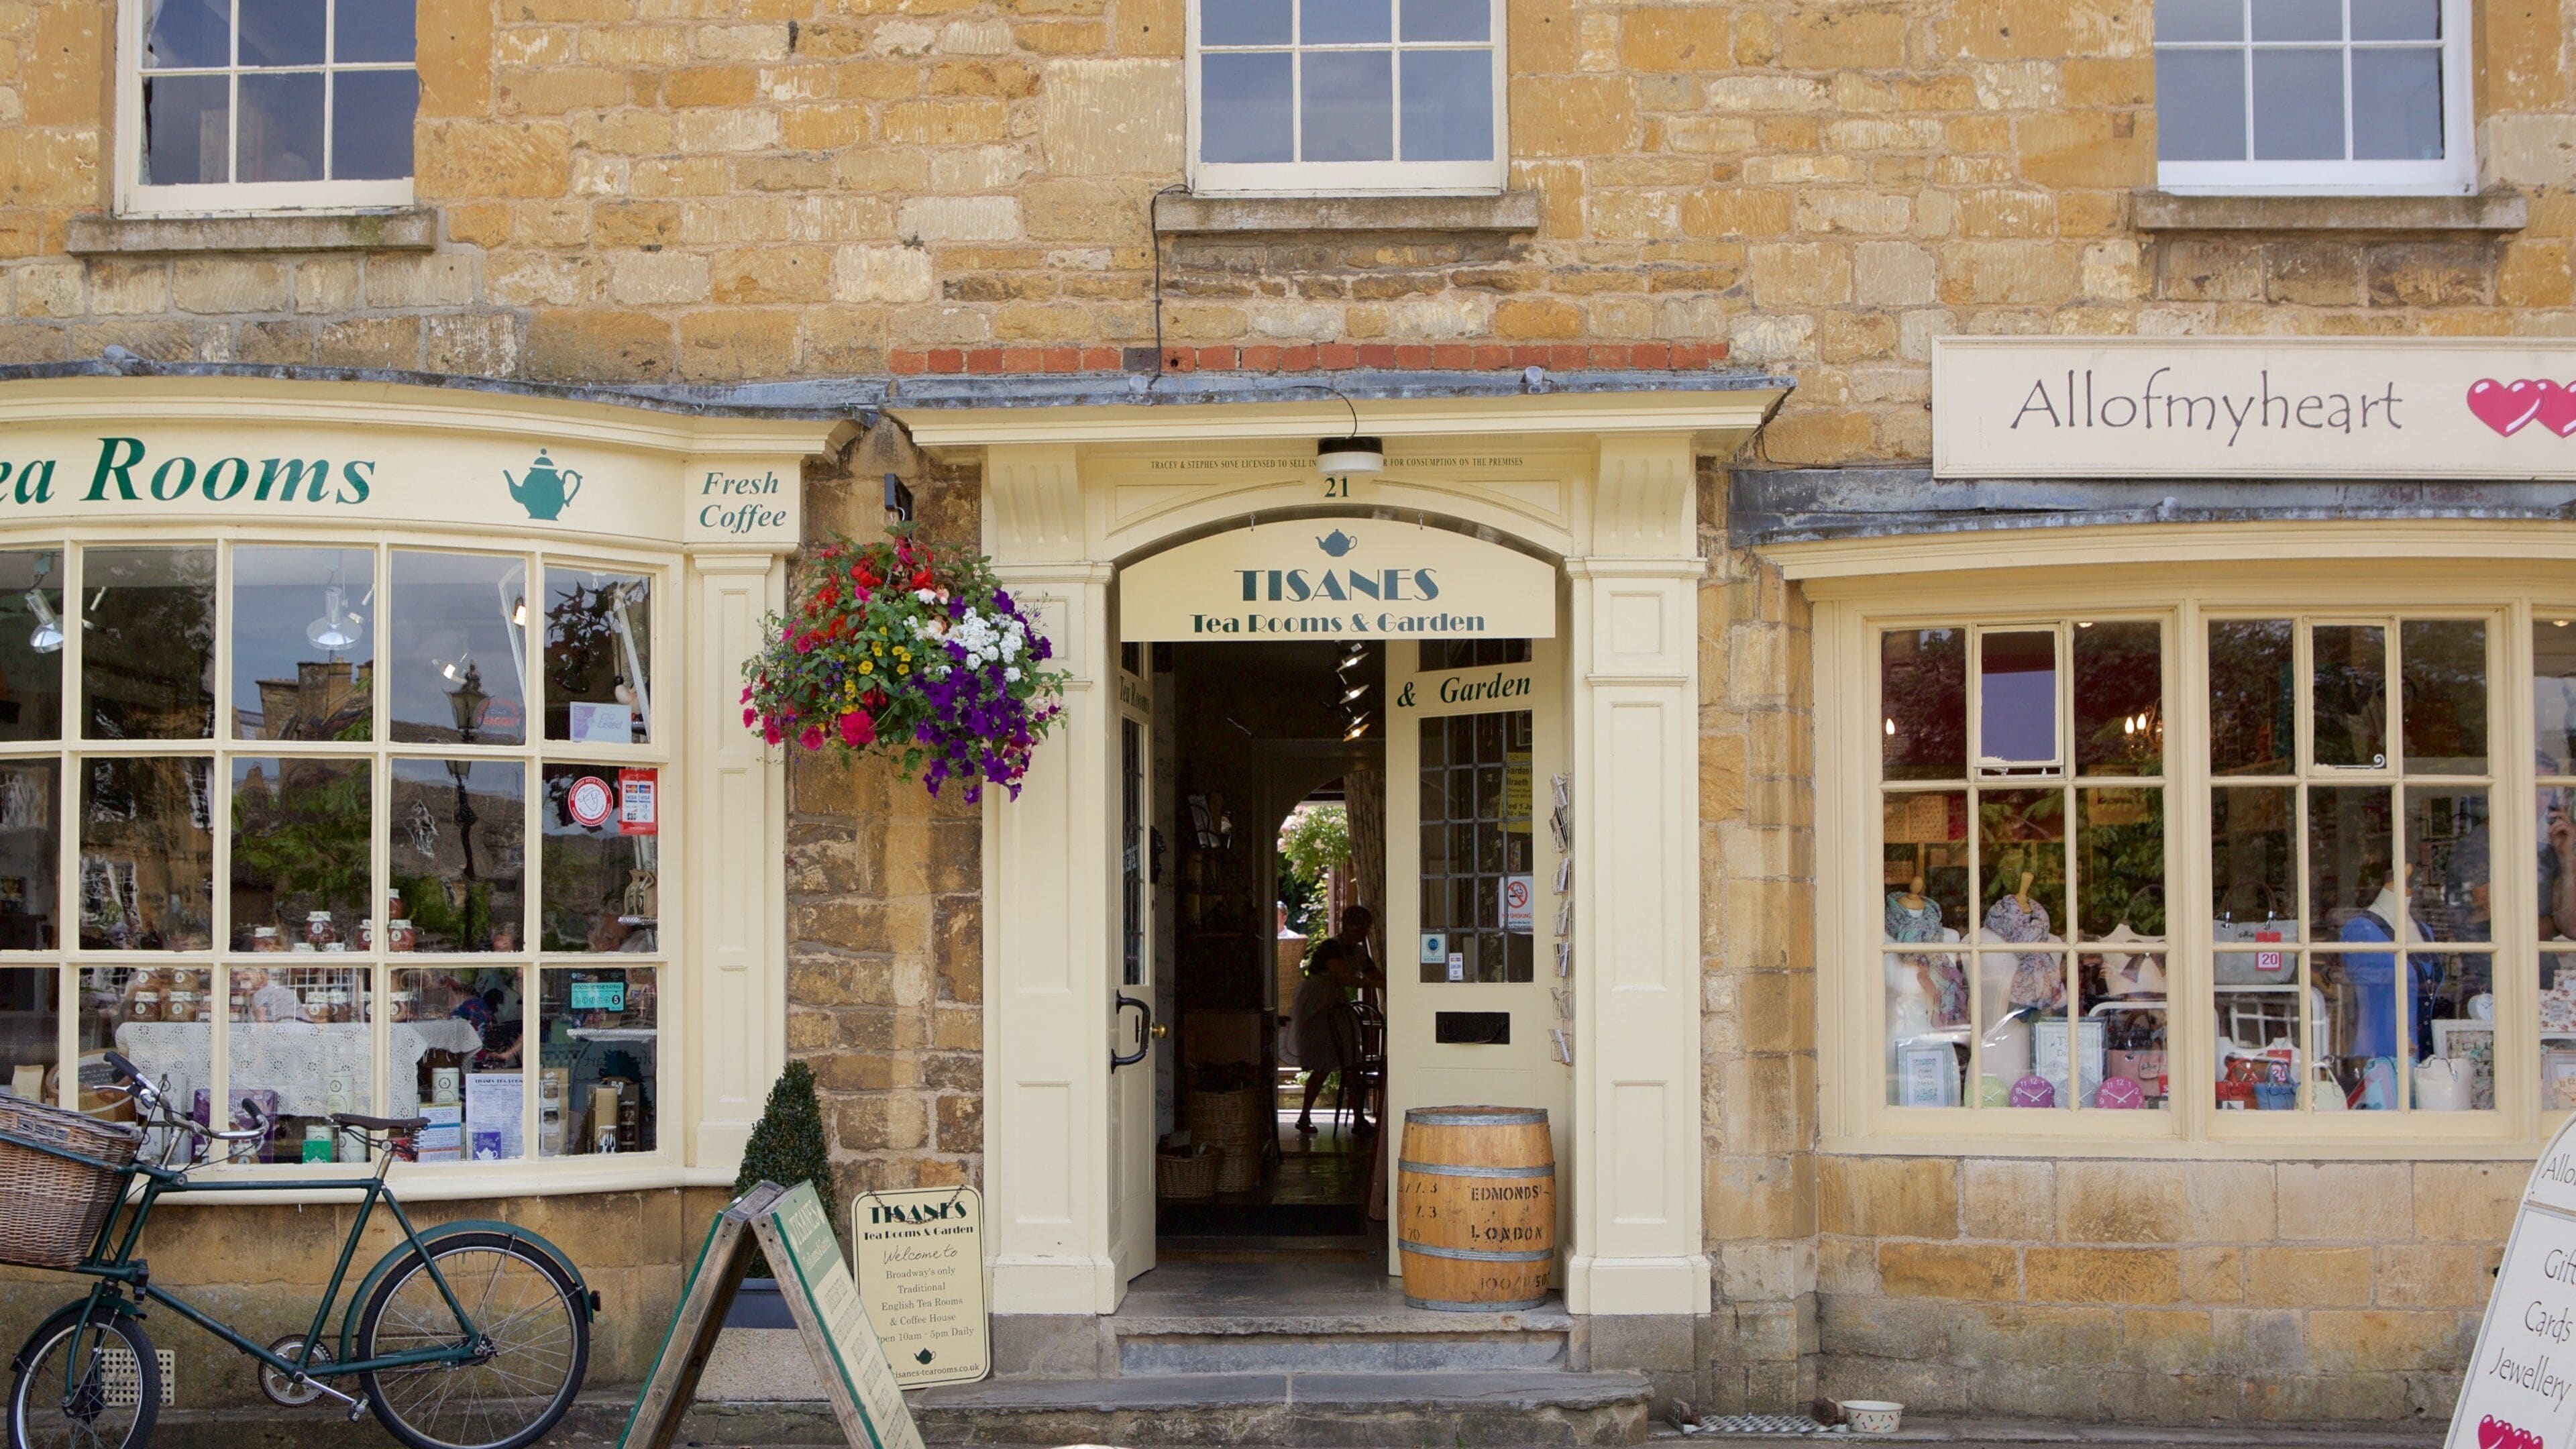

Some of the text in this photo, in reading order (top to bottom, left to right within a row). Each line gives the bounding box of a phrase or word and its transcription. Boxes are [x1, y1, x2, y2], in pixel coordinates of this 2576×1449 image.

[2010, 367, 2402, 446] Allofmyheart
[80, 437, 376, 504] Rooms
[1151, 461, 1177, 469] TRACEY
[1187, 460, 1218, 468] STEPHEN
[1221, 460, 1239, 468] SONE
[1242, 460, 1275, 468] LICENSED
[1278, 460, 1287, 468] TO
[1289, 459, 1307, 467] SELL
[1390, 458, 1404, 466] FOR
[1406, 458, 1456, 466] CONSUMPTION
[1472, 458, 1487, 466] THE
[1489, 458, 1523, 466] PREMISES
[701, 471, 778, 494] Fresh
[1324, 477, 1349, 498] 21
[700, 504, 786, 533] Coffee
[1234, 568, 1439, 602] TISANES
[1189, 612, 1485, 633] Tea Rooms & Garden
[1120, 676, 1149, 714] Tea Rooms
[1397, 672, 1531, 708] & Garden
[597, 720, 623, 730] Listed
[2261, 953, 2278, 965] 20
[613, 996, 619, 1004] 5
[2542, 1153, 2576, 1186] Allo
[789, 1199, 820, 1245] TISANES
[868, 1201, 967, 1224] TISANES
[863, 1232, 882, 1240] Tea
[885, 1229, 921, 1239] Rooms
[933, 1226, 974, 1236] Garden
[1471, 1225, 1542, 1241] LONDON
[883, 1244, 958, 1265] Welcome to
[886, 1266, 956, 1279] Broadway's only
[897, 1282, 946, 1294] Traditional
[881, 1297, 963, 1311] English Tea Rooms
[890, 1313, 956, 1326] & Coffee House
[2524, 1301, 2573, 1343] Cards
[899, 1333, 922, 1342] 10am
[930, 1330, 949, 1340] 5pm
[951, 1327, 974, 1337] Daily
[894, 1364, 979, 1379] isanes-tearooms.co.uk
[2489, 1348, 2572, 1412] Jewellery
